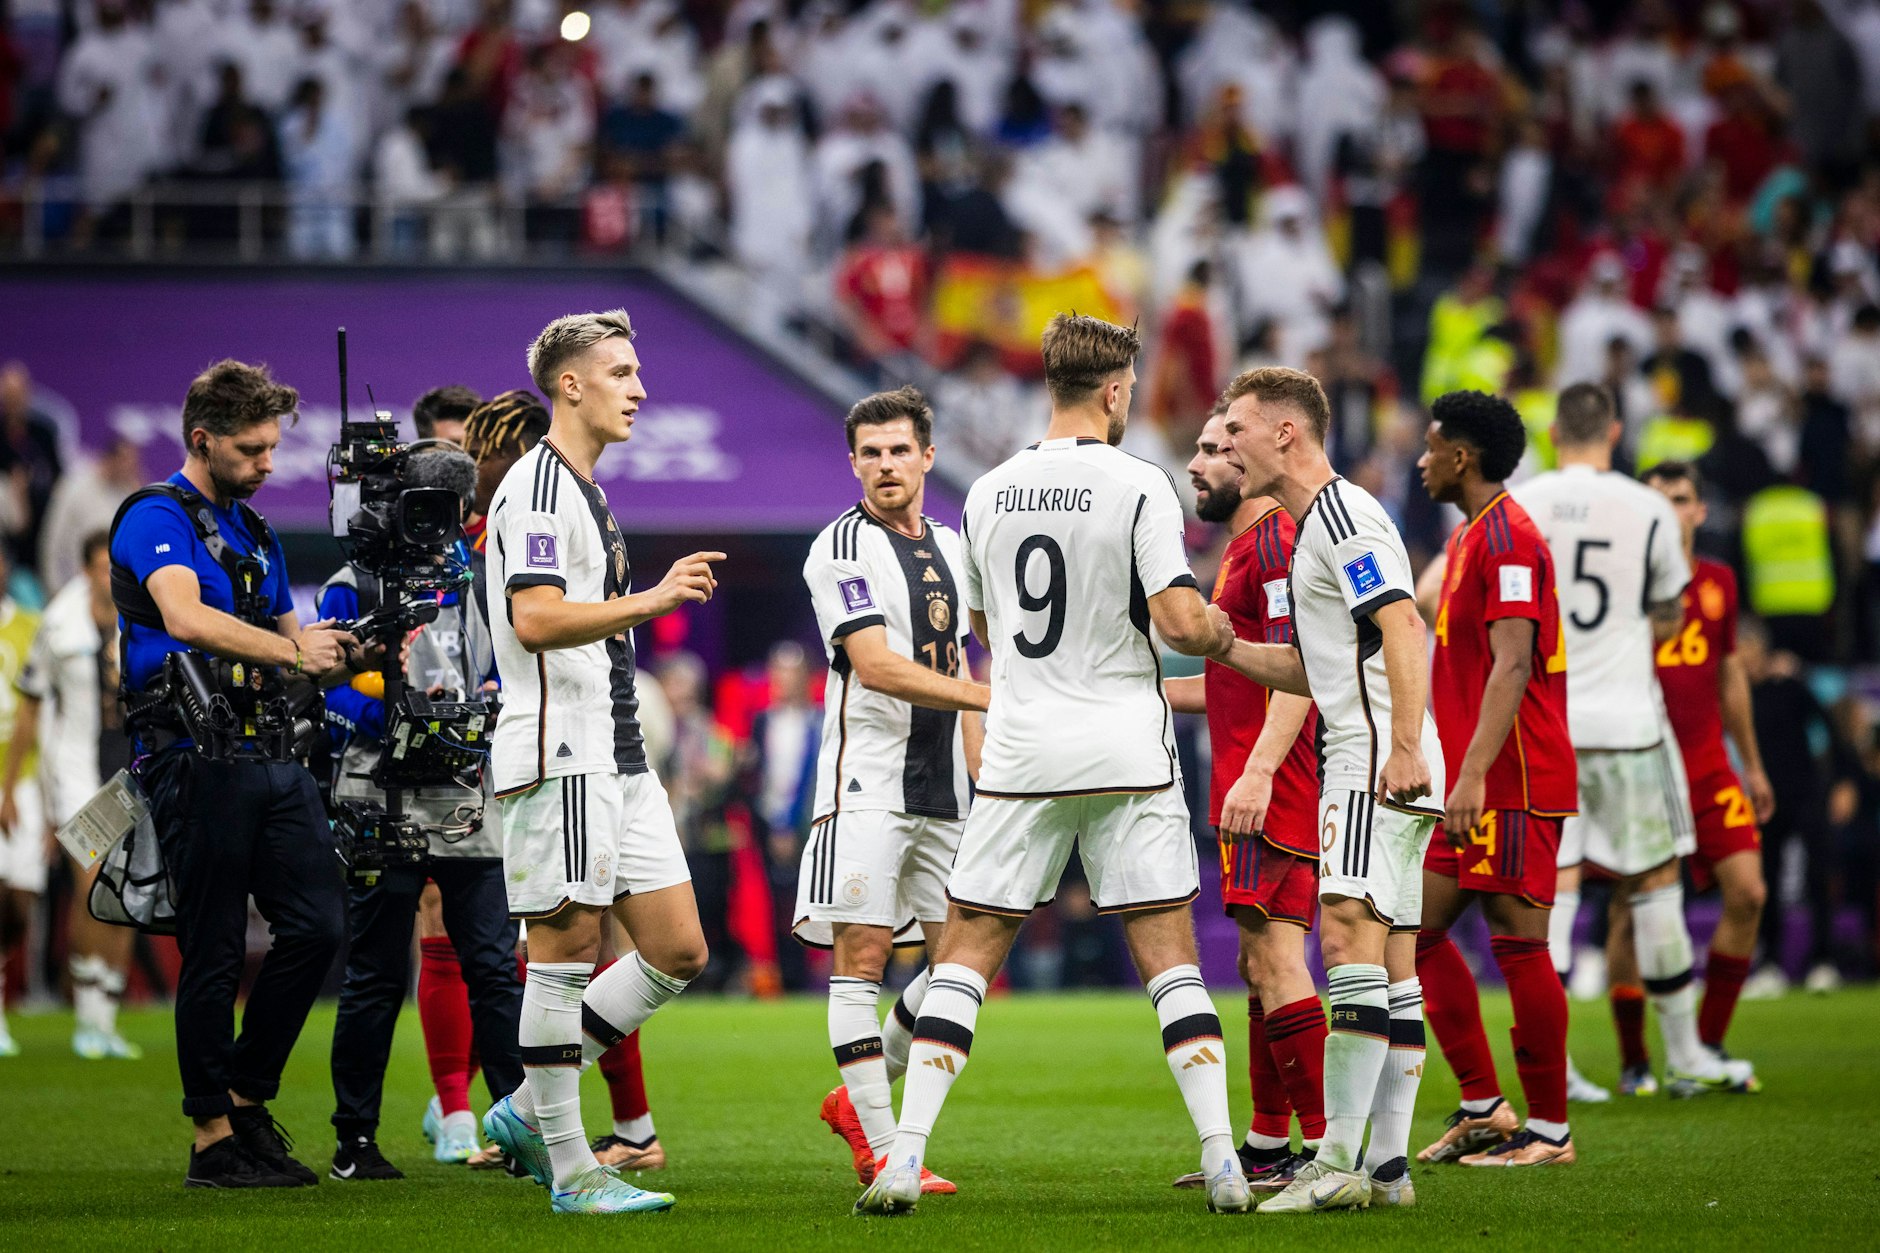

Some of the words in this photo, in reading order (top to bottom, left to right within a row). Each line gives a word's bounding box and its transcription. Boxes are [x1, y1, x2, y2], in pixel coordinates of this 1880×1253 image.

[995, 485, 1093, 514] FÜLLKRUG
[1012, 534, 1067, 659] 9
[1546, 536, 1612, 632] 5
[921, 640, 958, 680] 18
[1656, 618, 1709, 667] 26
[1321, 803, 1339, 853] 6
[1455, 809, 1497, 857] 4
[851, 1041, 881, 1054] DFB
